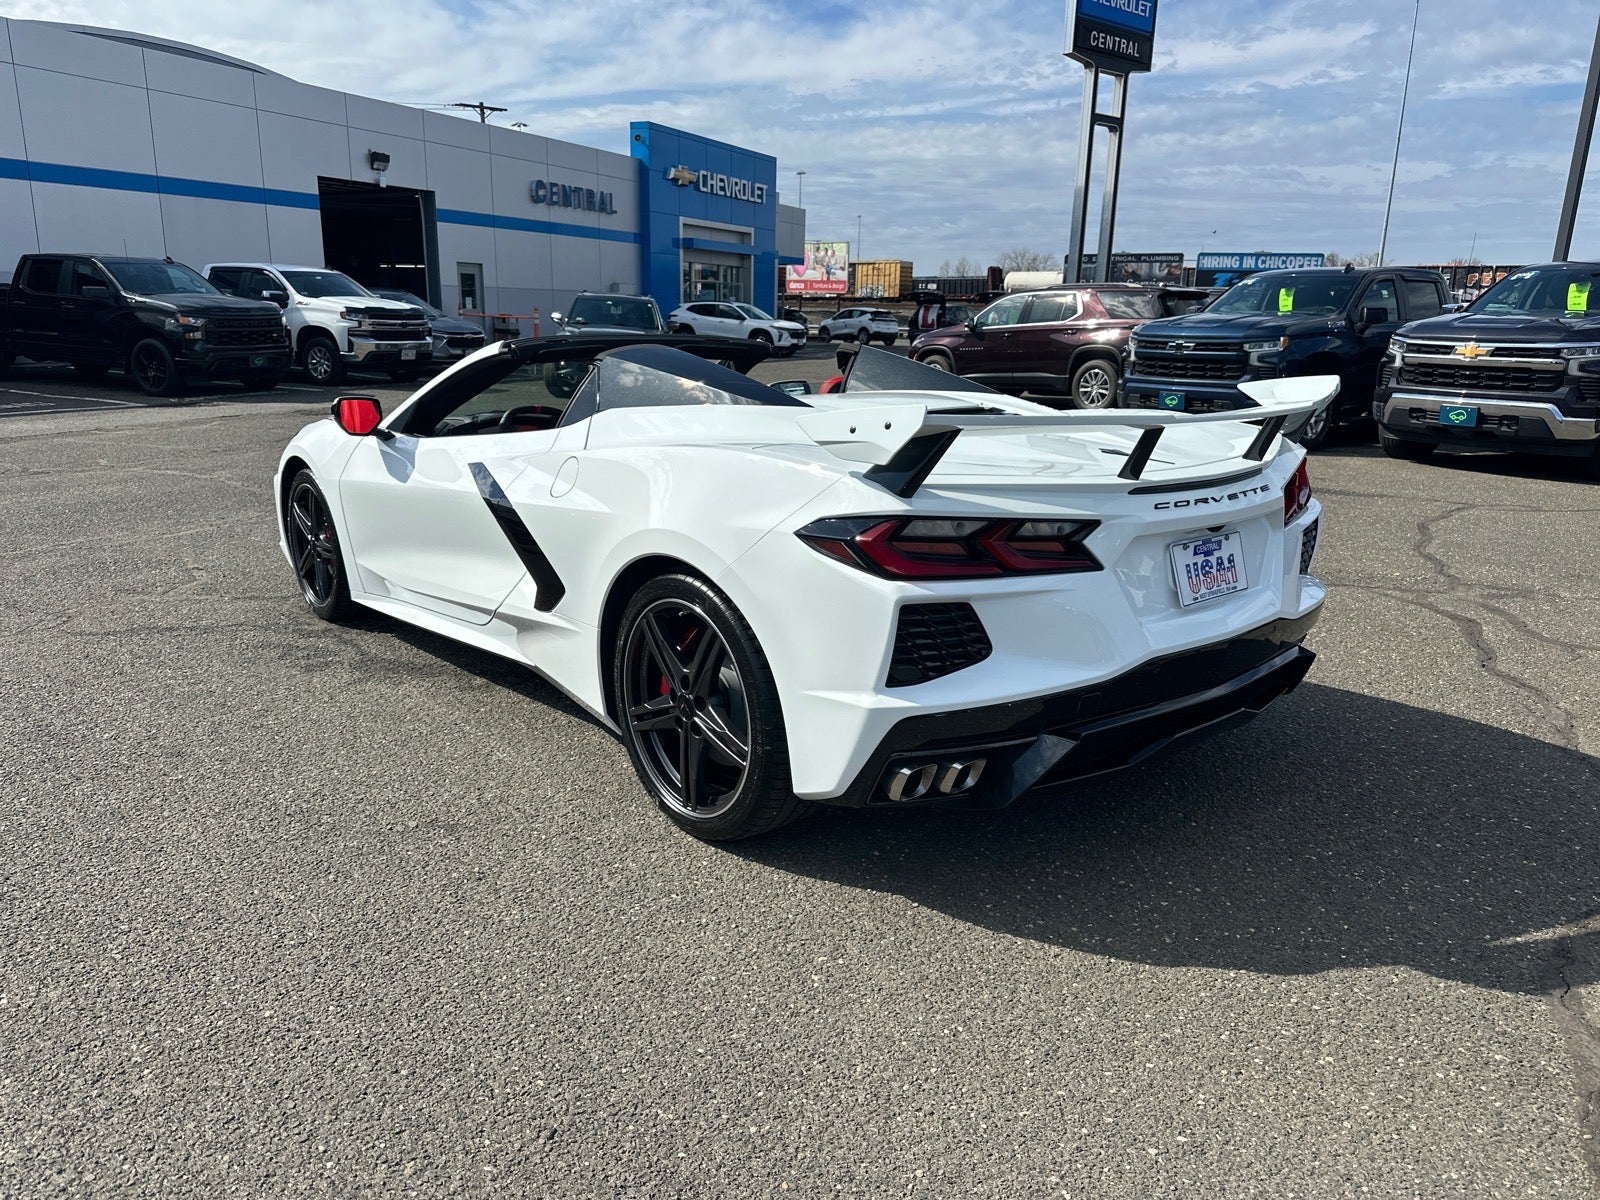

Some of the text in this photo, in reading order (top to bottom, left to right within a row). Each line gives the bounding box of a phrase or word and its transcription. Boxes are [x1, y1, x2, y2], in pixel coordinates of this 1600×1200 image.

[1091, 0, 1152, 17] VROLET
[1090, 31, 1139, 57] CENTRAL
[531, 179, 617, 214] CENTRAL
[700, 170, 768, 204] CHEVROLET
[1199, 256, 1323, 269] HIRING IN CHICOPEE!
[1154, 484, 1270, 510] CORVETTE
[1196, 541, 1220, 554] CENTRAL
